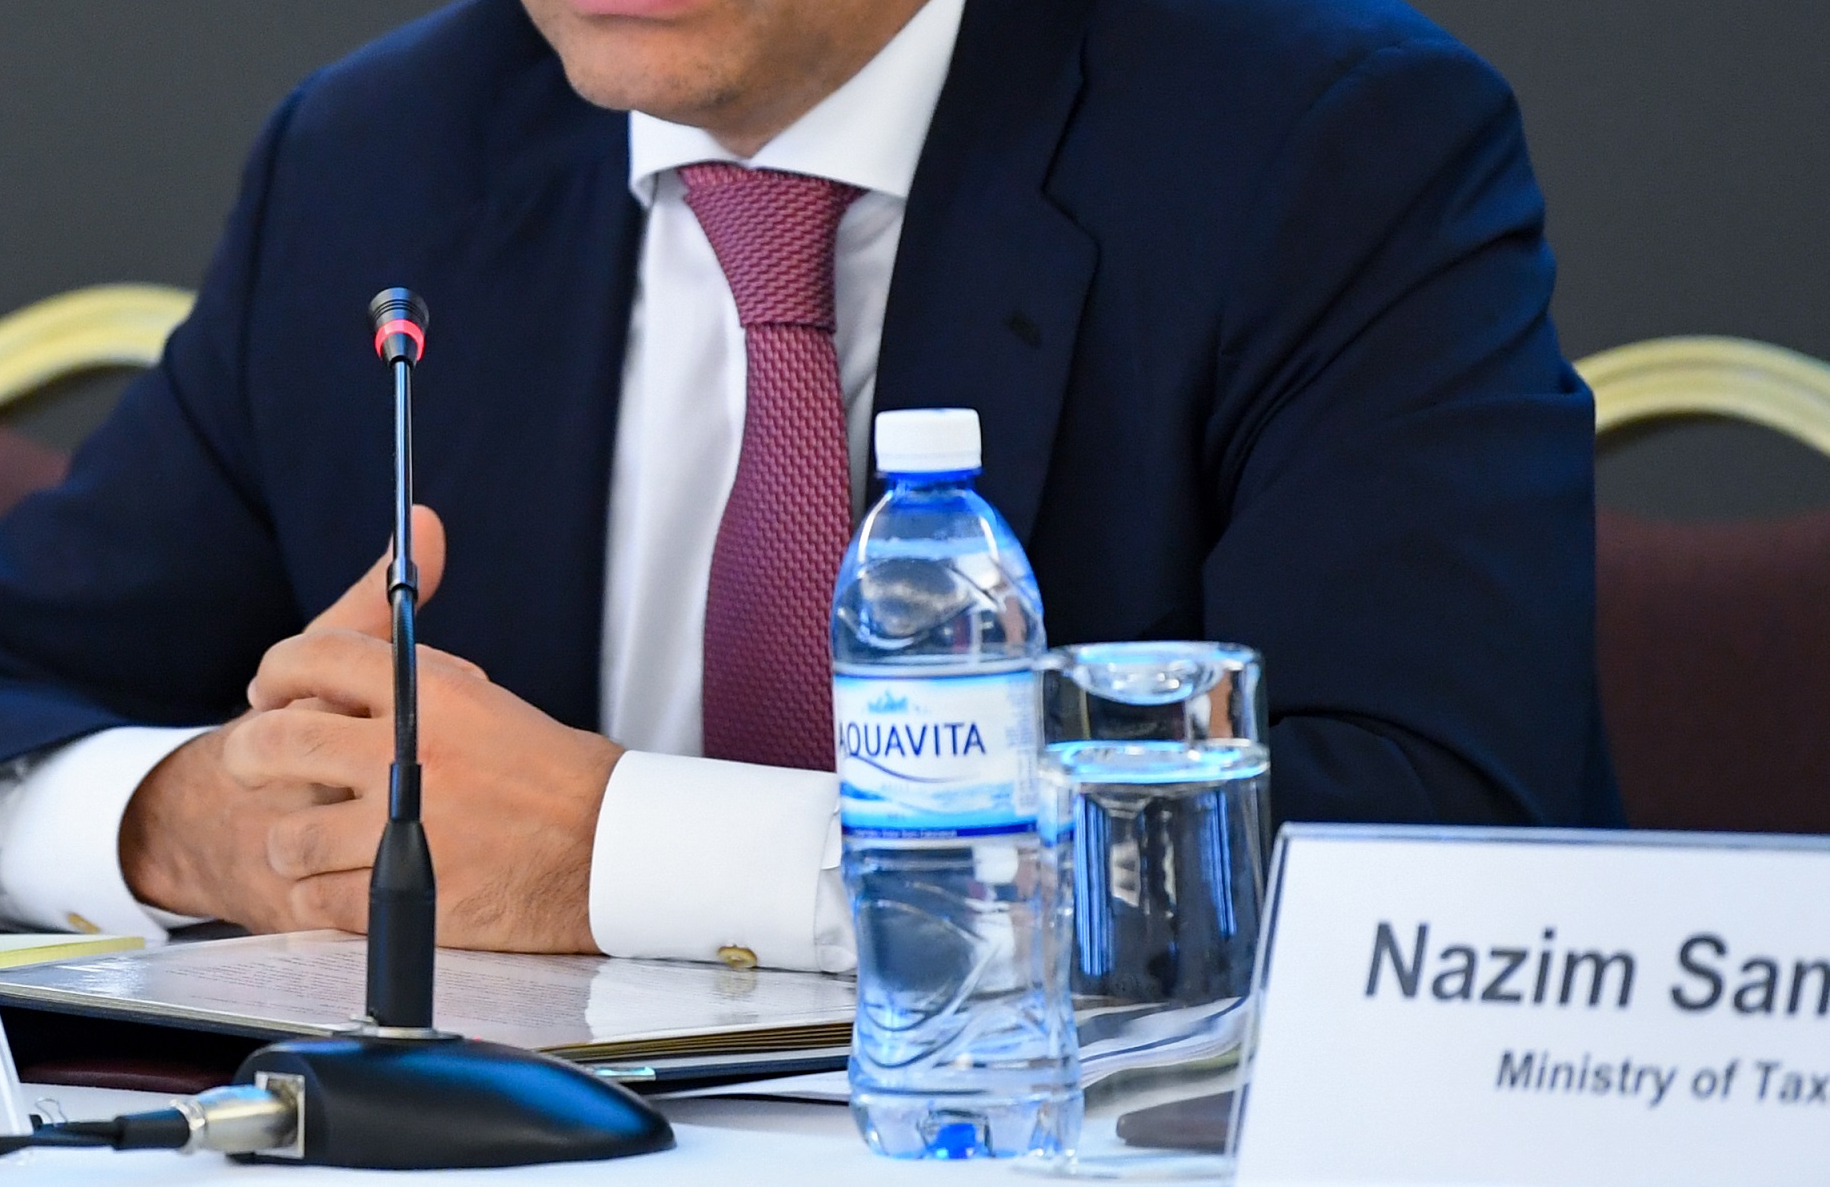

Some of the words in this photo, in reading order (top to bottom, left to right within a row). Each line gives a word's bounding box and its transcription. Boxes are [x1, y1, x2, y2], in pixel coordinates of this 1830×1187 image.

[1365, 922, 1637, 1009] Nazim
[1495, 1049, 1678, 1109] Ministry
[1690, 1058, 1740, 1101] of
[1755, 1059, 1830, 1105] Tax
